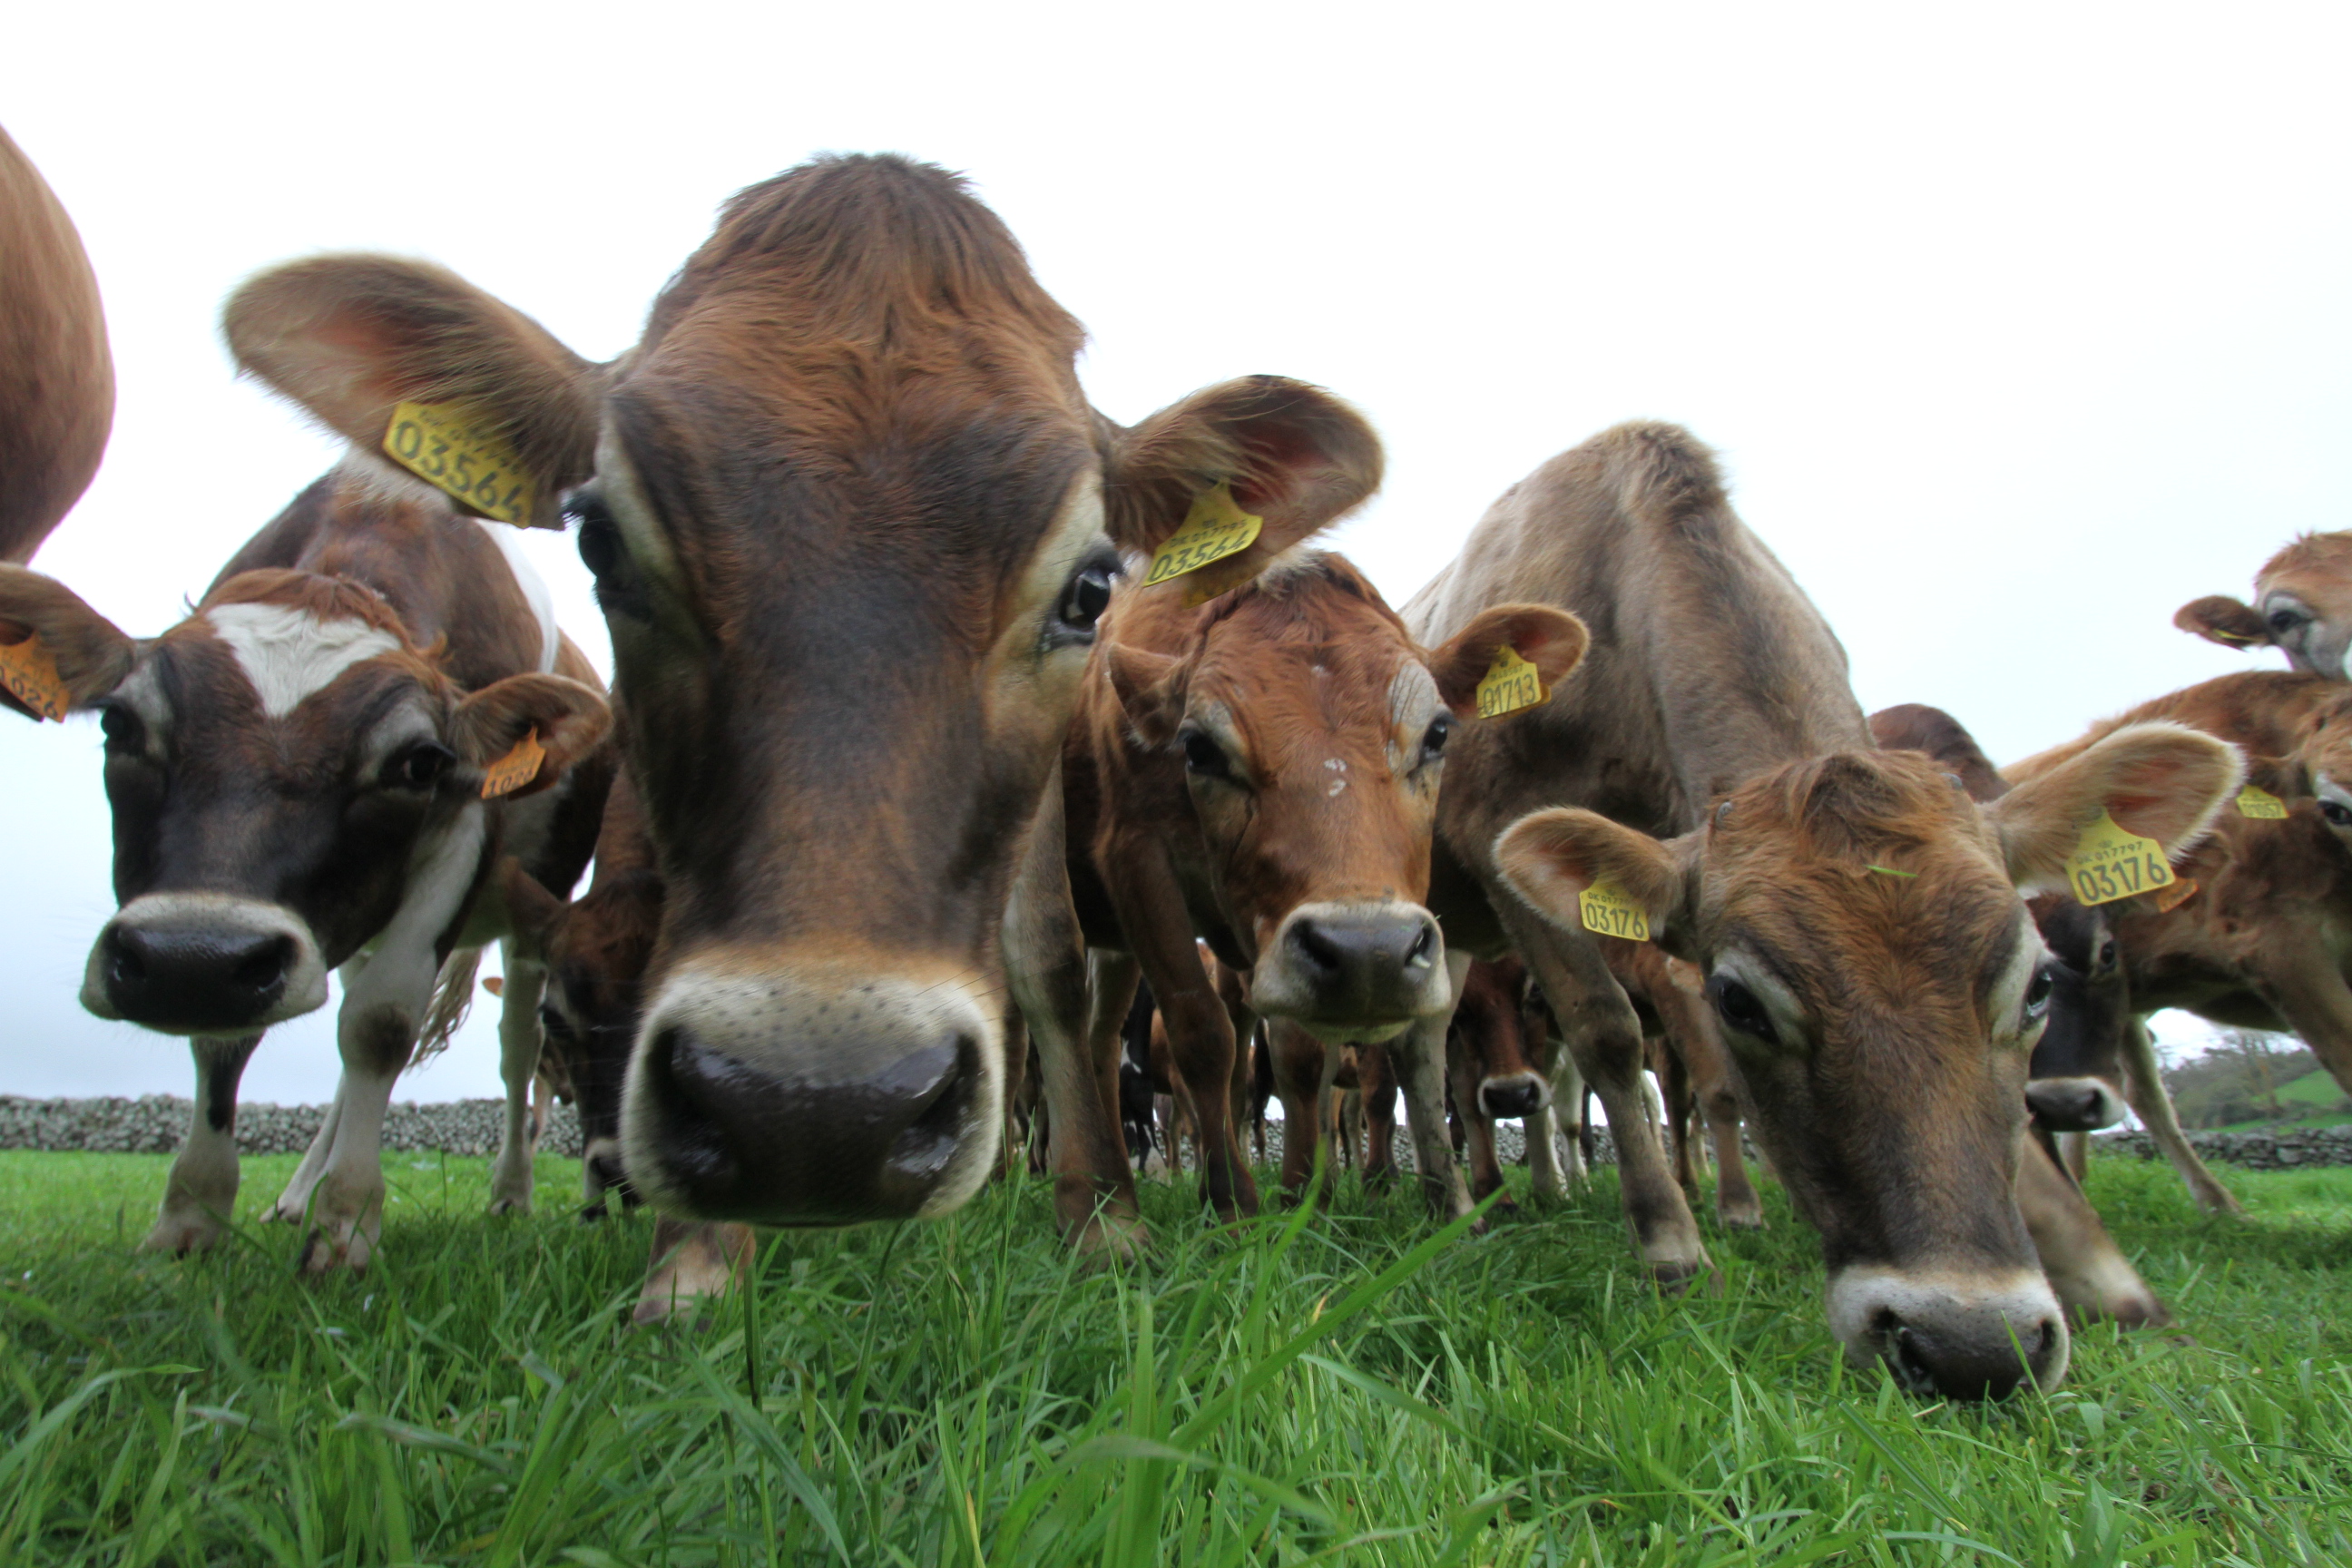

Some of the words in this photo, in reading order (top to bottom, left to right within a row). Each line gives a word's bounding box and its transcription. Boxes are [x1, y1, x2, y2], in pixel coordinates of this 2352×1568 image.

[394, 421, 524, 521] 03564
[1149, 530, 1250, 583] 03564
[1483, 673, 1536, 716] 01713
[2077, 853, 2167, 902] 03176
[1585, 903, 1644, 938] 03176
